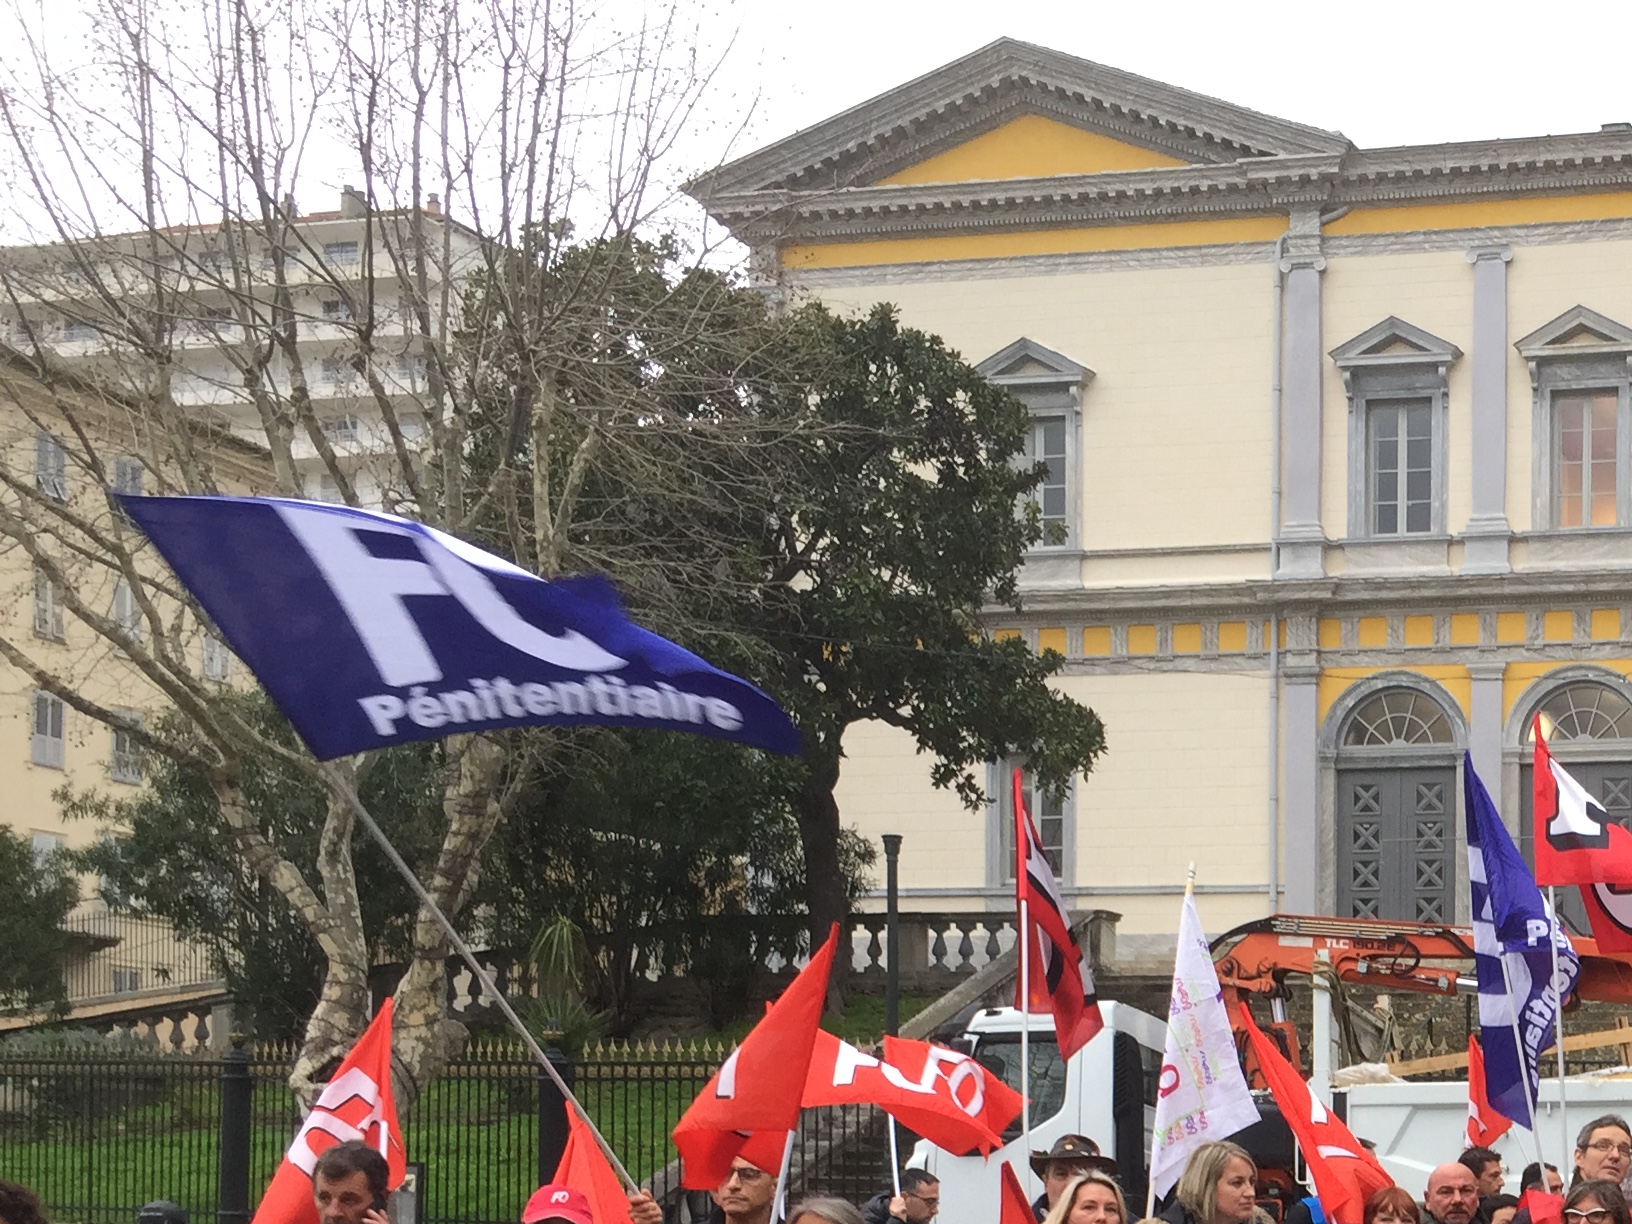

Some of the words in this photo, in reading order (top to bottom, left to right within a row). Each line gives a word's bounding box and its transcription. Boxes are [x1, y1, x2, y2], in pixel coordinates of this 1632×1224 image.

[357, 674, 745, 737] Pénitentiaire
[1325, 937, 1349, 949] TLC
[551, 1191, 570, 1204] FO
